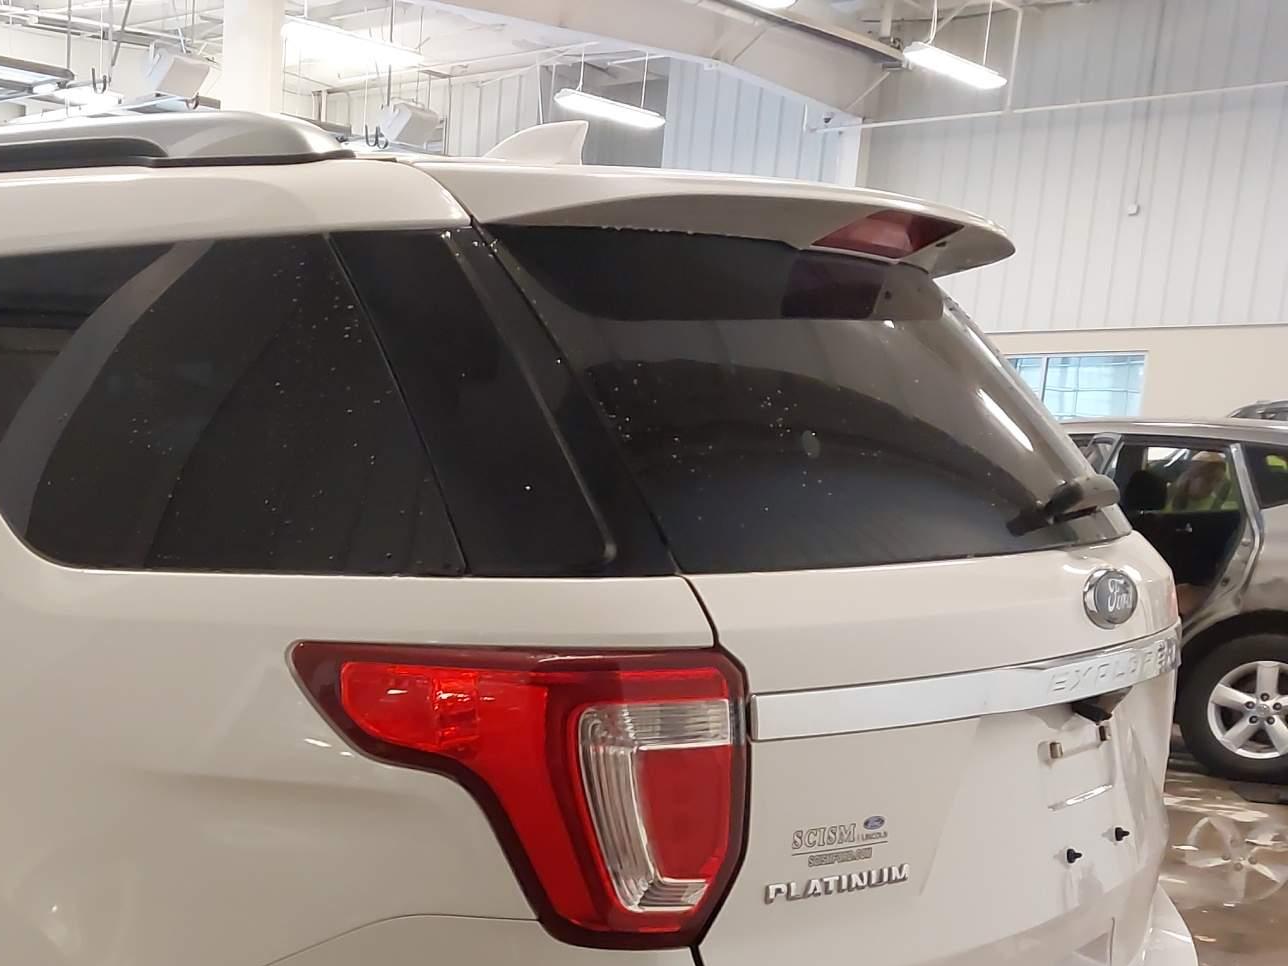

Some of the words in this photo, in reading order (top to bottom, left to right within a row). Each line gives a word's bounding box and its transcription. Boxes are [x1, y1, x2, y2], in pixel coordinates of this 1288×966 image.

[1107, 577, 1133, 613] Ford
[791, 823, 857, 850] SCISM
[764, 863, 910, 905] PLATINUM
